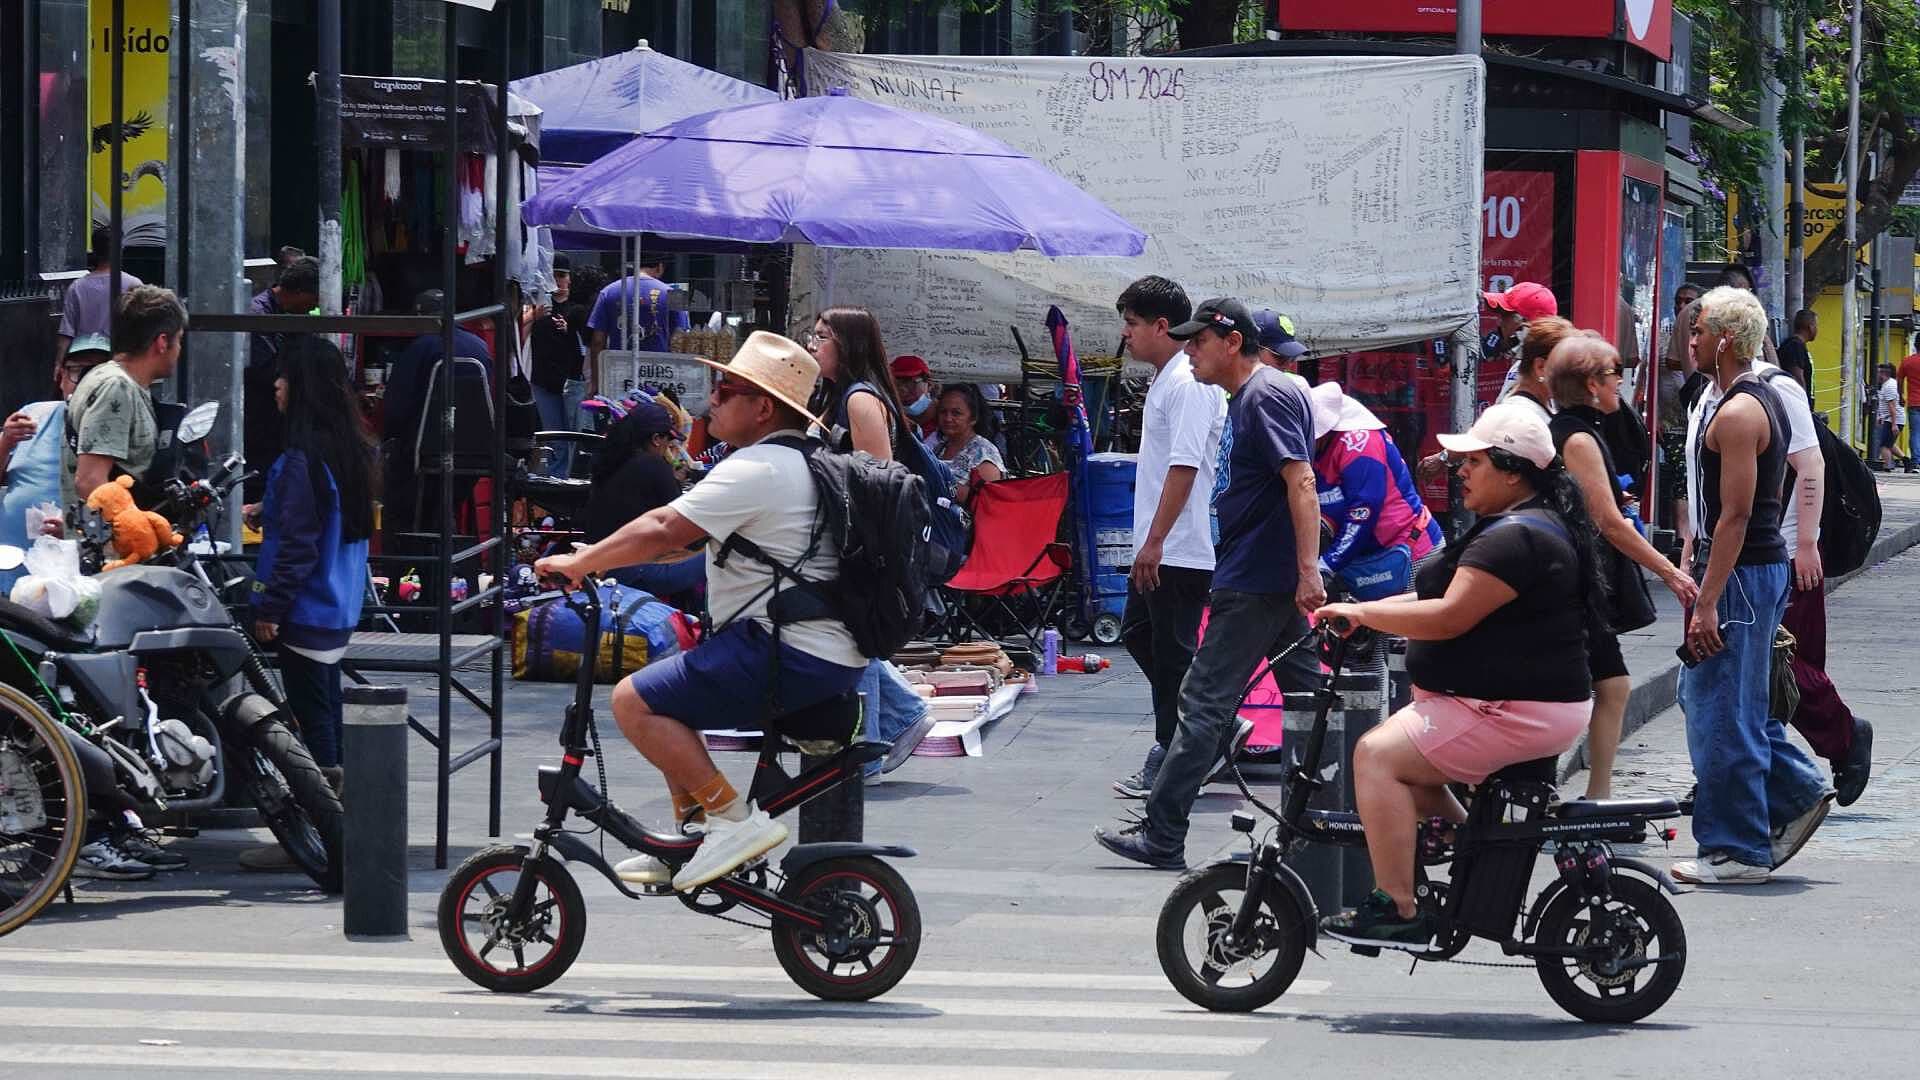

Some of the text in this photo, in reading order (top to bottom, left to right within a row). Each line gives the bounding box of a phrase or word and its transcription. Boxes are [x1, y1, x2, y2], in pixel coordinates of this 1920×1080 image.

[1090, 61, 1185, 101] 8M-2026
[1785, 223, 1824, 237] pgo
[634, 365, 674, 379] GUAS
